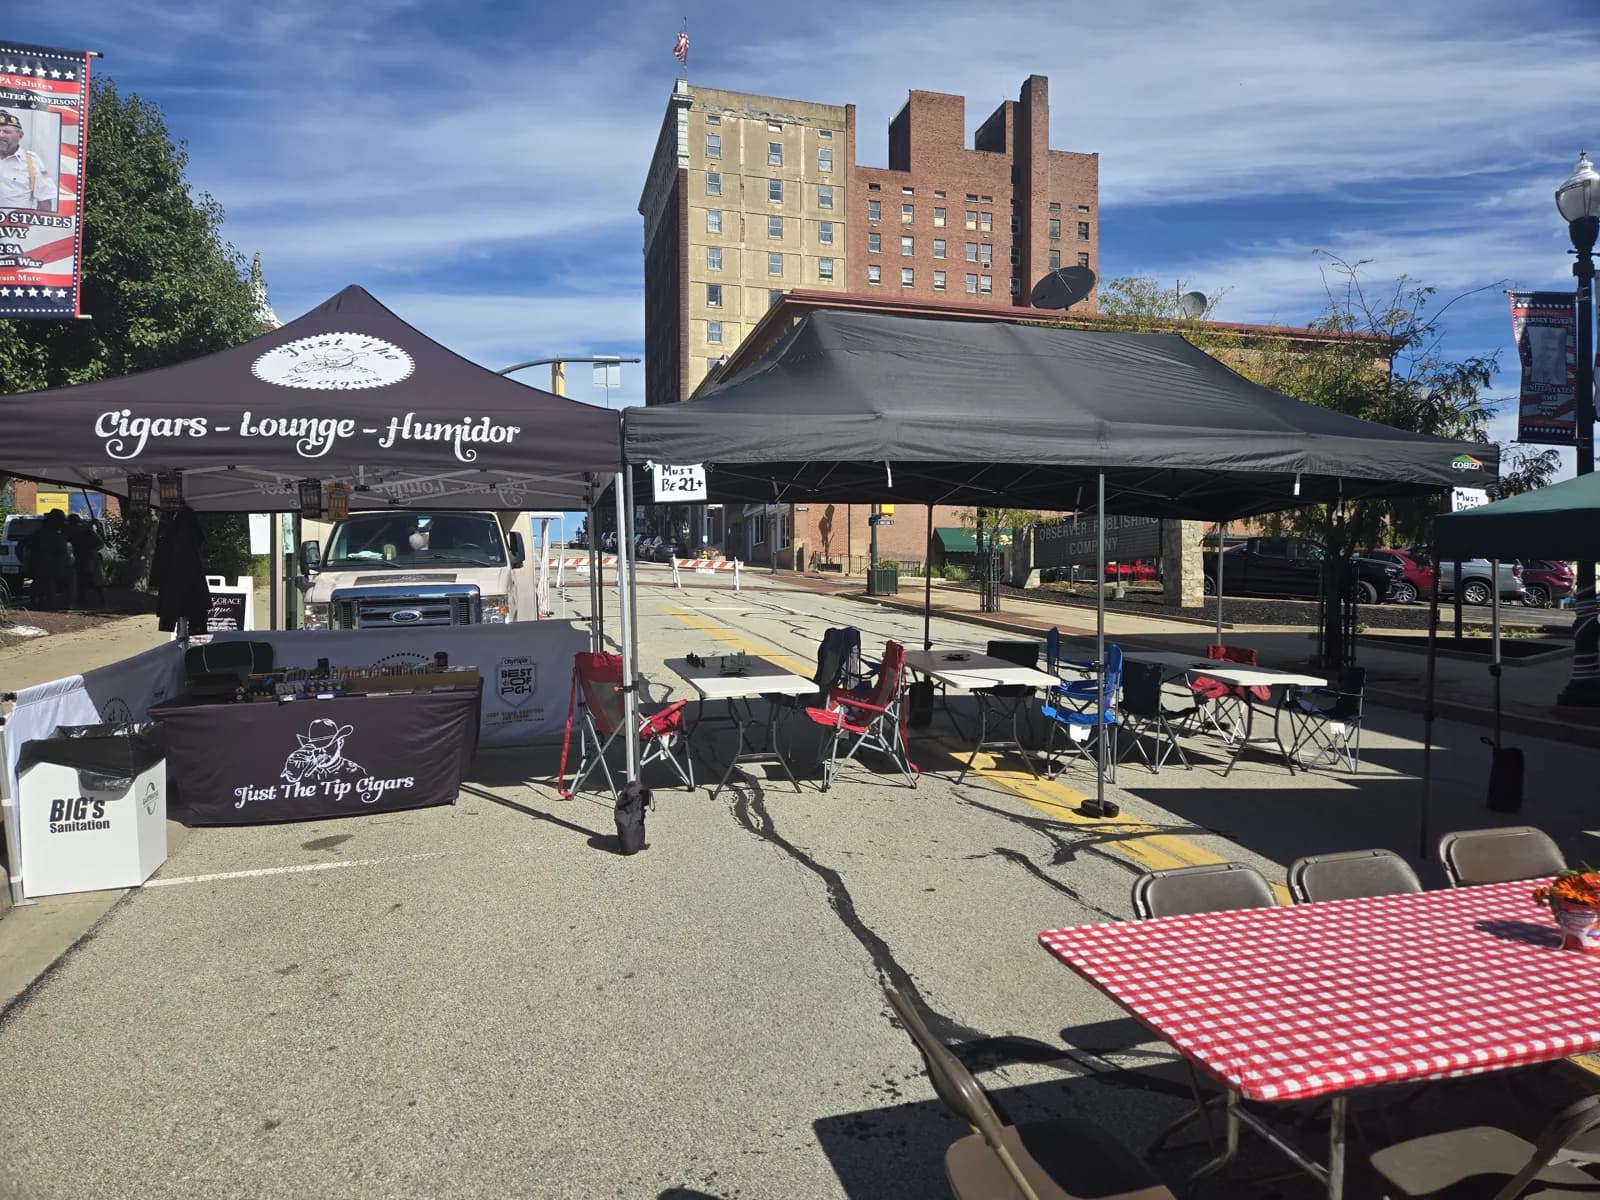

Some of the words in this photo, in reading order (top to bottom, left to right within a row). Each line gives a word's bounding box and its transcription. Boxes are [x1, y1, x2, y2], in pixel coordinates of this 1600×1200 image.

[15, 78, 54, 91] Salutes
[28, 95, 78, 106] ANDERSON
[9, 213, 72, 228] STATES
[17, 257, 43, 267] War
[279, 338, 343, 358] Just
[95, 409, 208, 459] Cigars
[239, 411, 355, 458] Lounge
[378, 412, 520, 462] Humidor
[678, 477, 704, 492] 21+
[1038, 523, 1088, 541] OBSERVER
[1070, 536, 1119, 555] COMPNY
[501, 668, 532, 679] BEST
[510, 677, 532, 687] OF
[501, 685, 532, 696] PGH
[234, 784, 277, 808] Just
[280, 782, 317, 799] The
[320, 779, 351, 801] Tip
[355, 776, 414, 804] Cigars
[49, 796, 105, 822] BIG's
[49, 820, 110, 834] Sanitation
